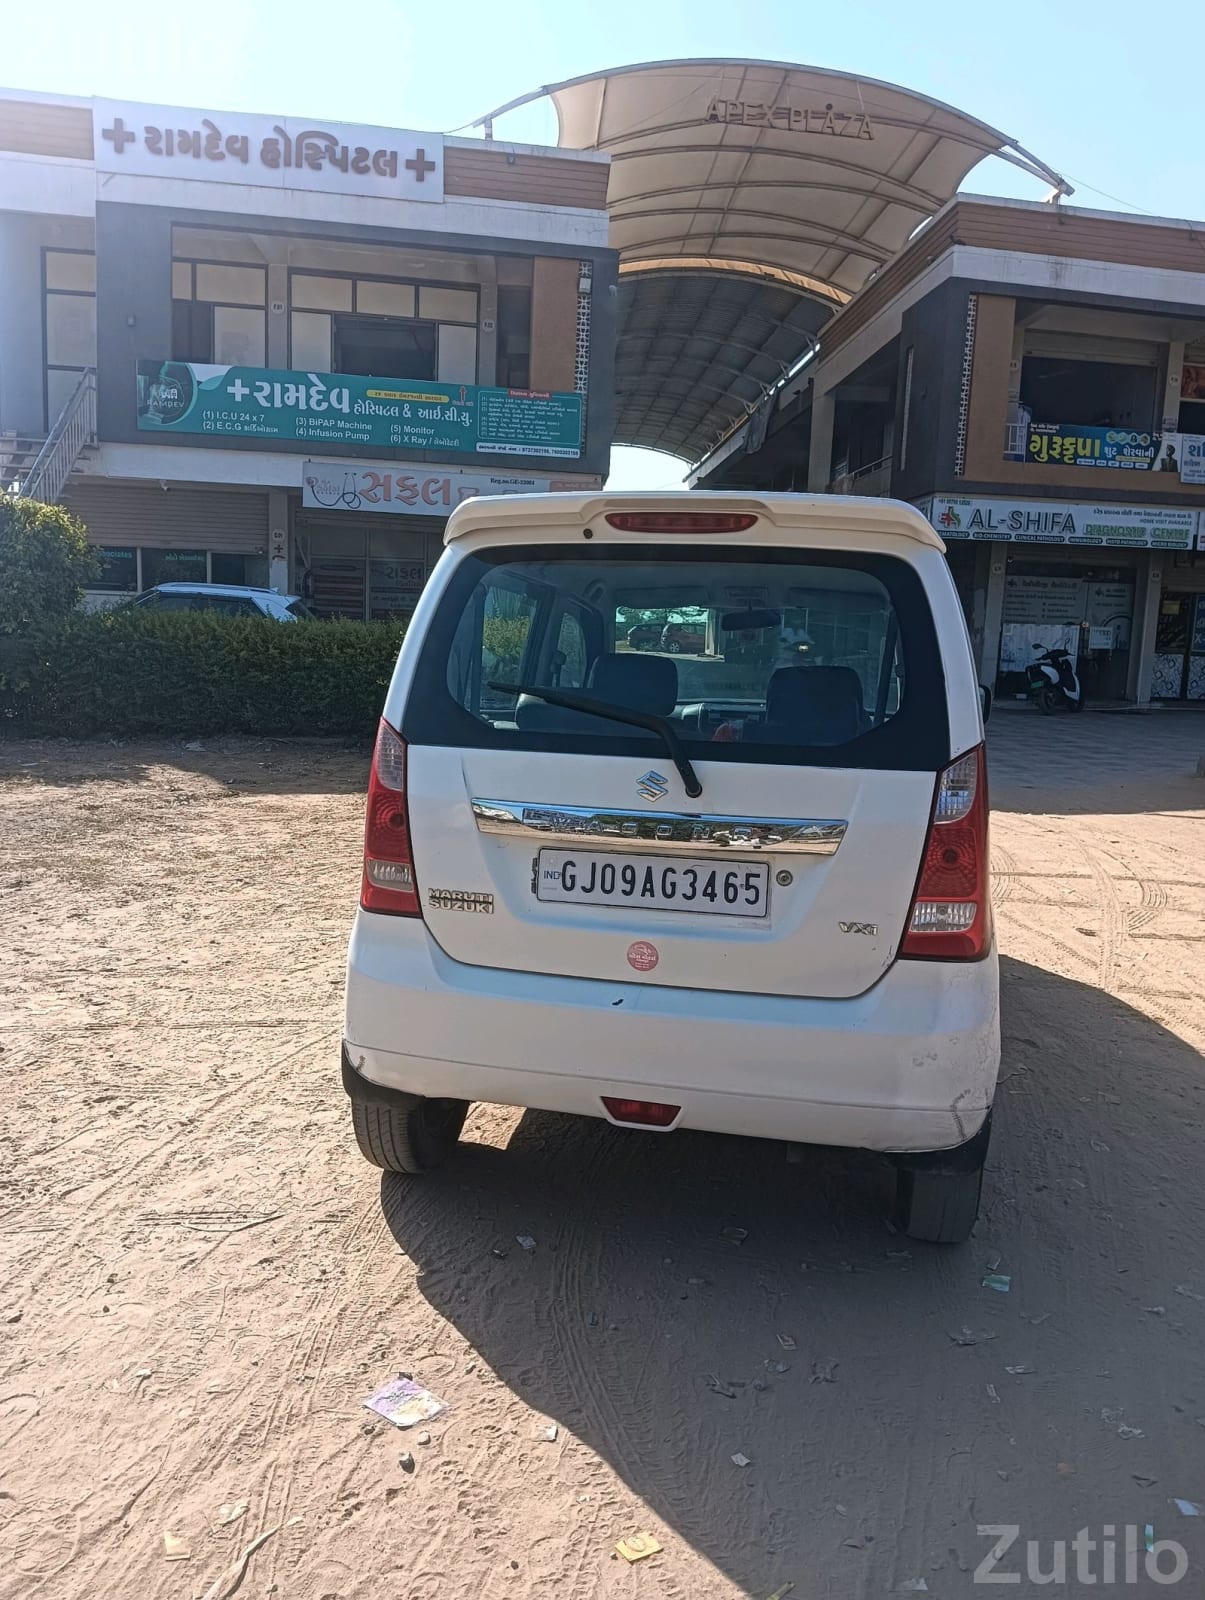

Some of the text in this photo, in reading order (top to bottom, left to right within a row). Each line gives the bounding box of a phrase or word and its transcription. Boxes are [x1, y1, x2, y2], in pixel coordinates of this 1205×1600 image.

[704, 99, 875, 141] APEX PLAZA
[144, 118, 250, 164] રામદેવ
[253, 373, 351, 413] રામદેવ
[147, 399, 185, 408] RAMDEV
[402, 403, 412, 418] &
[203, 410, 214, 420] (1)
[216, 411, 238, 421] I.C.U
[239, 412, 250, 421] 24
[259, 414, 265, 422] 7
[296, 416, 373, 430] (3) BiPAP Machine
[203, 421, 214, 431] (2)
[216, 421, 242, 431] E.C.G
[391, 424, 435, 435] (5) Monitor
[296, 427, 370, 441] (4) Infusion Pump
[391, 435, 401, 444] (6)
[403, 435, 410, 443] X
[411, 436, 428, 446] Ray
[967, 508, 1077, 534] AL-SHIFA
[1083, 523, 1147, 538] DIAGNOSTIC
[561, 860, 761, 906] GJ09AG3465
[428, 888, 494, 903] MARUTI
[428, 899, 494, 914] SUZUKI
